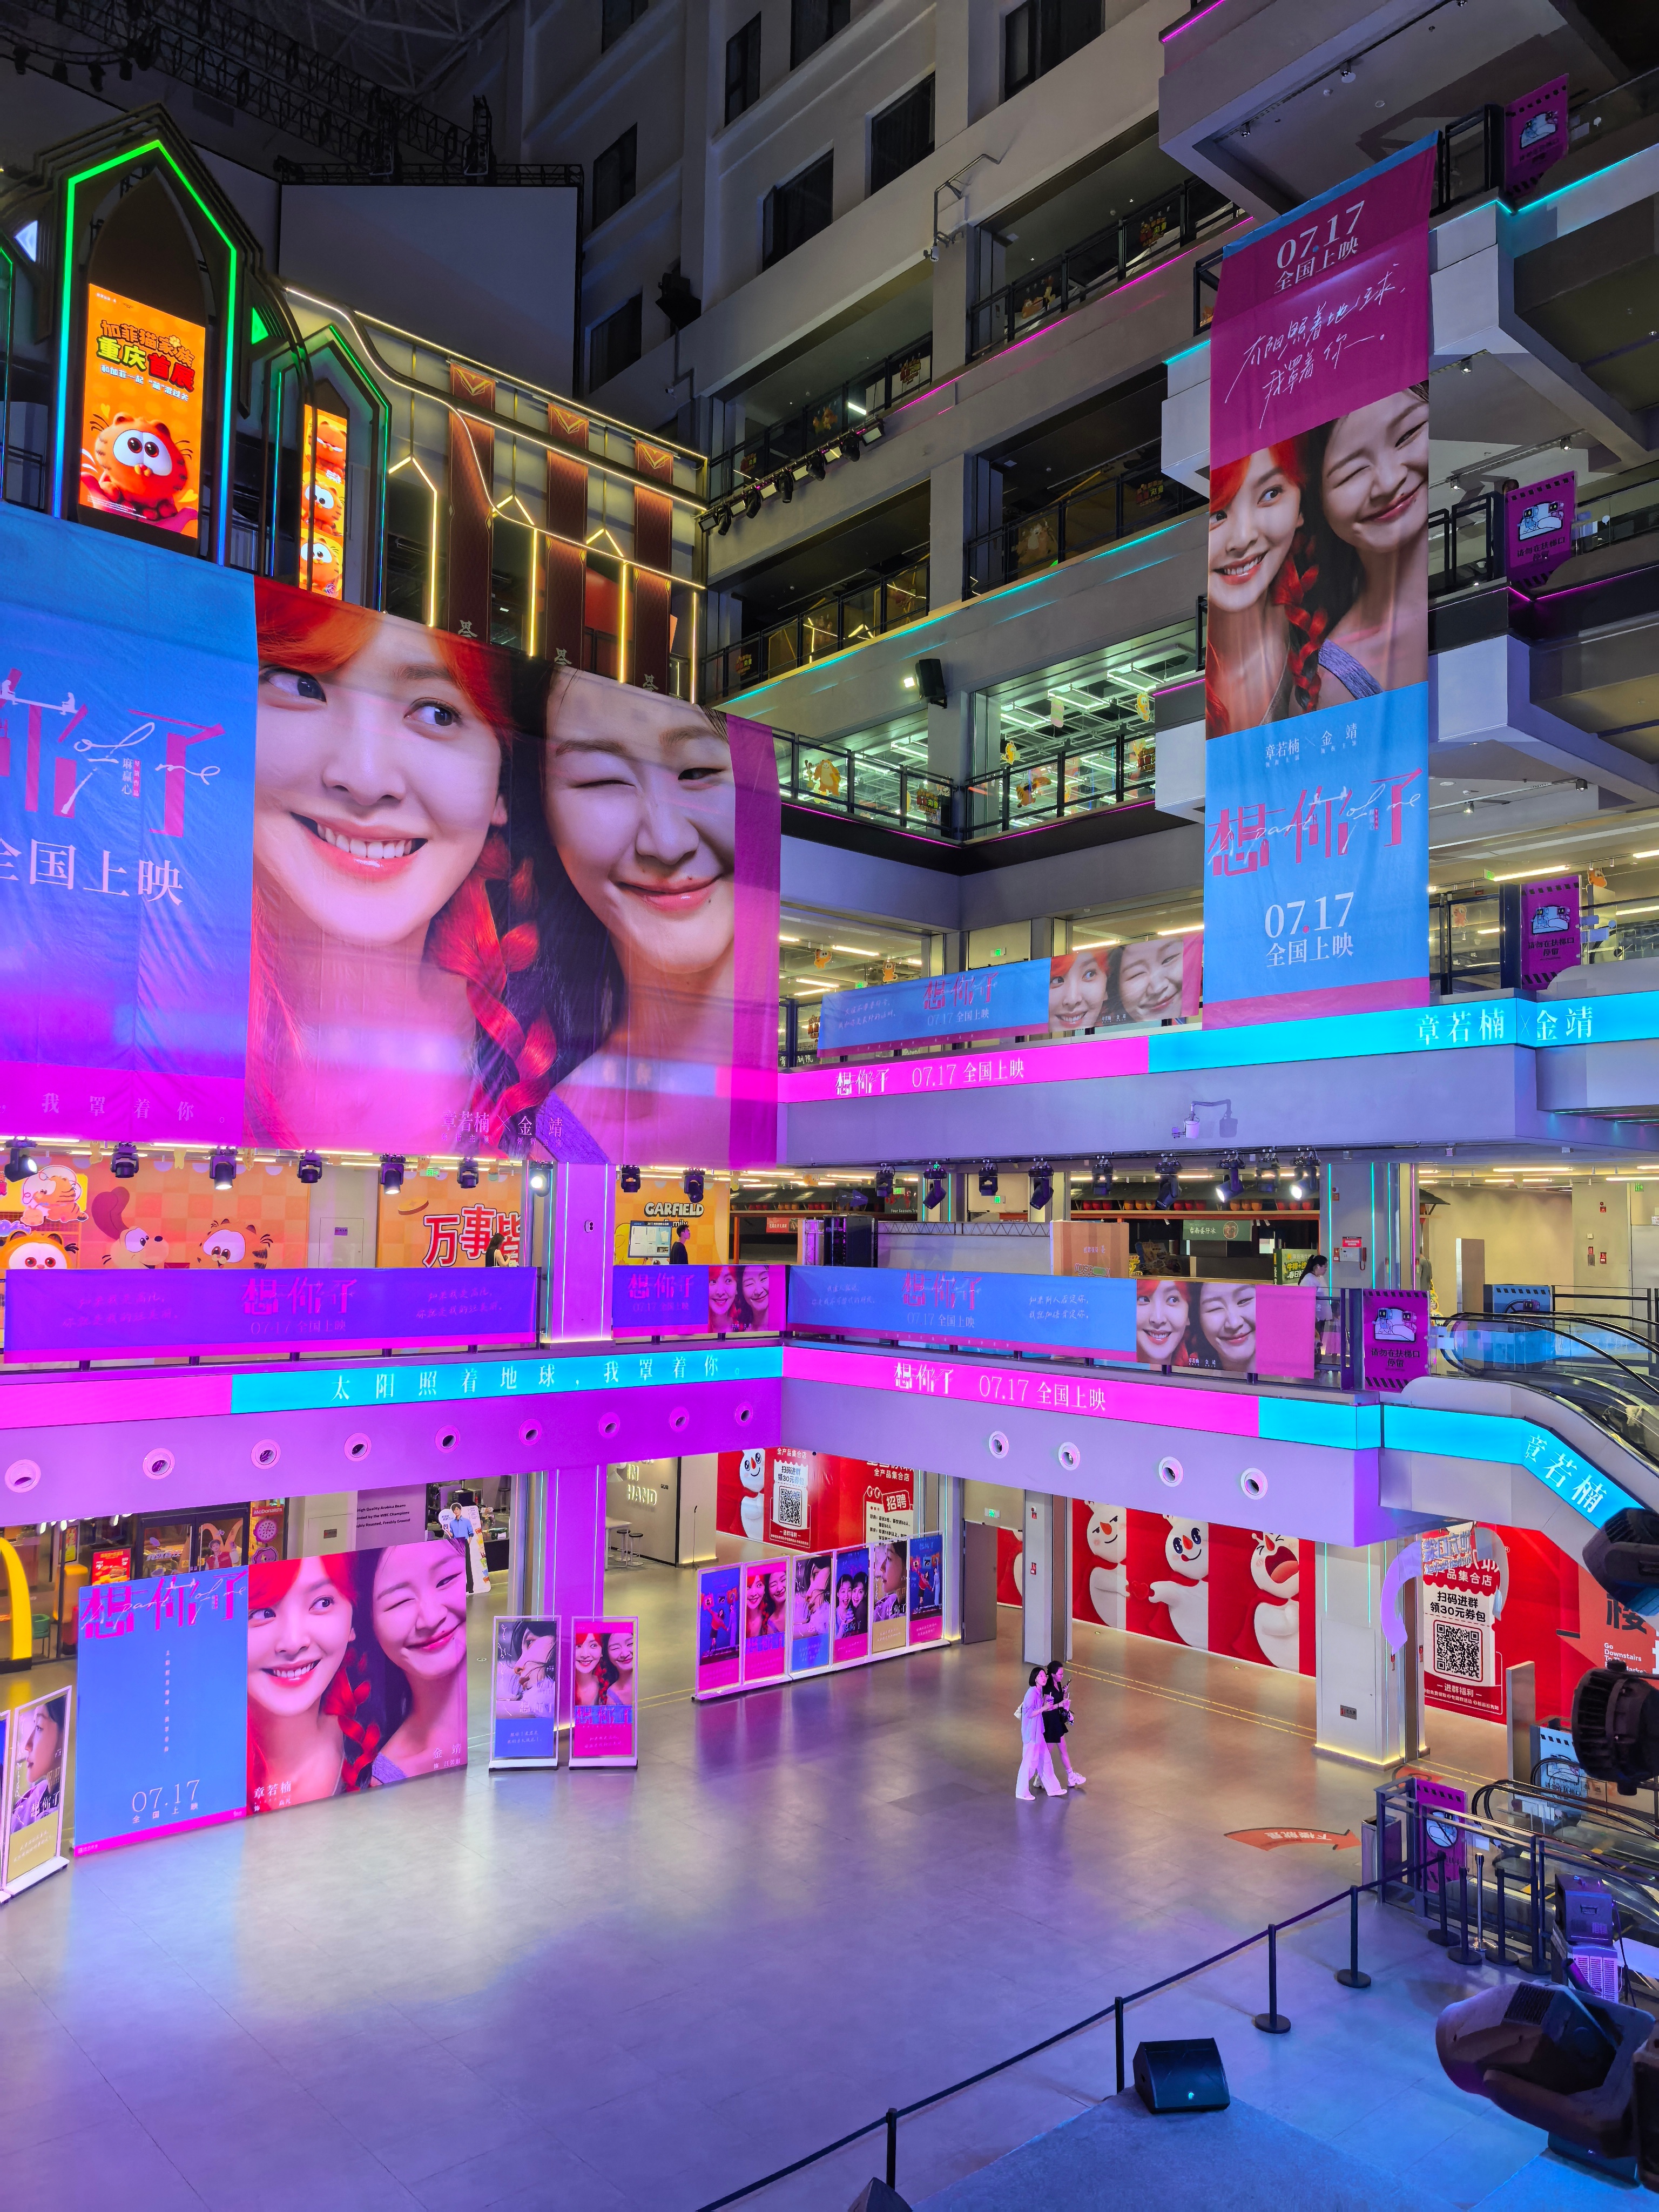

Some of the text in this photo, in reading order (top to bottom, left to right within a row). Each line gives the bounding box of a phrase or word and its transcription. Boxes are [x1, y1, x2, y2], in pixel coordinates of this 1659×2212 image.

[1277, 200, 1365, 269] 07.17
[1274, 238, 1359, 294] 全国上映
[100, 320, 195, 368] 加菲猫家族
[96, 335, 195, 392] 重庆首展
[1266, 723, 1357, 760] 章若楠 金靖
[1208, 767, 1422, 876] 想你了
[1265, 892, 1354, 939] 07.17
[1266, 932, 1354, 968] 全国上映
[1528, 937, 1574, 949] 请勿在扶梯口
[923, 972, 999, 1010] 想你了
[956, 1010, 989, 1023] 全国上映
[1415, 1006, 1593, 1045] 章若楠 金靖
[835, 1058, 1024, 1096] 想你了 07.17 全国上映
[442, 1110, 563, 1137] 章若楠 金靖
[644, 1202, 704, 1217] GARFIELD
[241, 1277, 357, 1316] 想你了
[628, 1272, 694, 1299] 想你了
[902, 1271, 982, 1310] 想你了
[298, 1319, 346, 1334] 全国上映
[939, 1314, 975, 1329] 全国上映
[1371, 1348, 1420, 1358] 请勿在扶梯口
[1387, 1357, 1404, 1367] 停留
[894, 1363, 1106, 1412] 想你了 07.17 全国上映
[777, 1447, 806, 1459] 全产品集合店
[781, 1466, 801, 1475] 扫码进群
[874, 1468, 909, 1481] 全产品集合店
[1524, 1434, 1607, 1513] 章若楠
[628, 1484, 657, 1506] HAND
[886, 1494, 907, 1511] 招聘
[253, 1507, 282, 1515] McDonald's
[80, 1570, 247, 1639] 想你了
[1430, 1601, 1486, 1622] 领30元券包
[1437, 1591, 1478, 1608] 扫码进群
[1604, 1649, 1642, 1662] Downstairs
[1444, 1683, 1474, 1697] 进群福利
[132, 1779, 200, 1812] 07.17
[254, 1781, 292, 1799] 章若楠
[30, 1791, 59, 1818] 想你了
[132, 1802, 199, 1824] 全国上映
